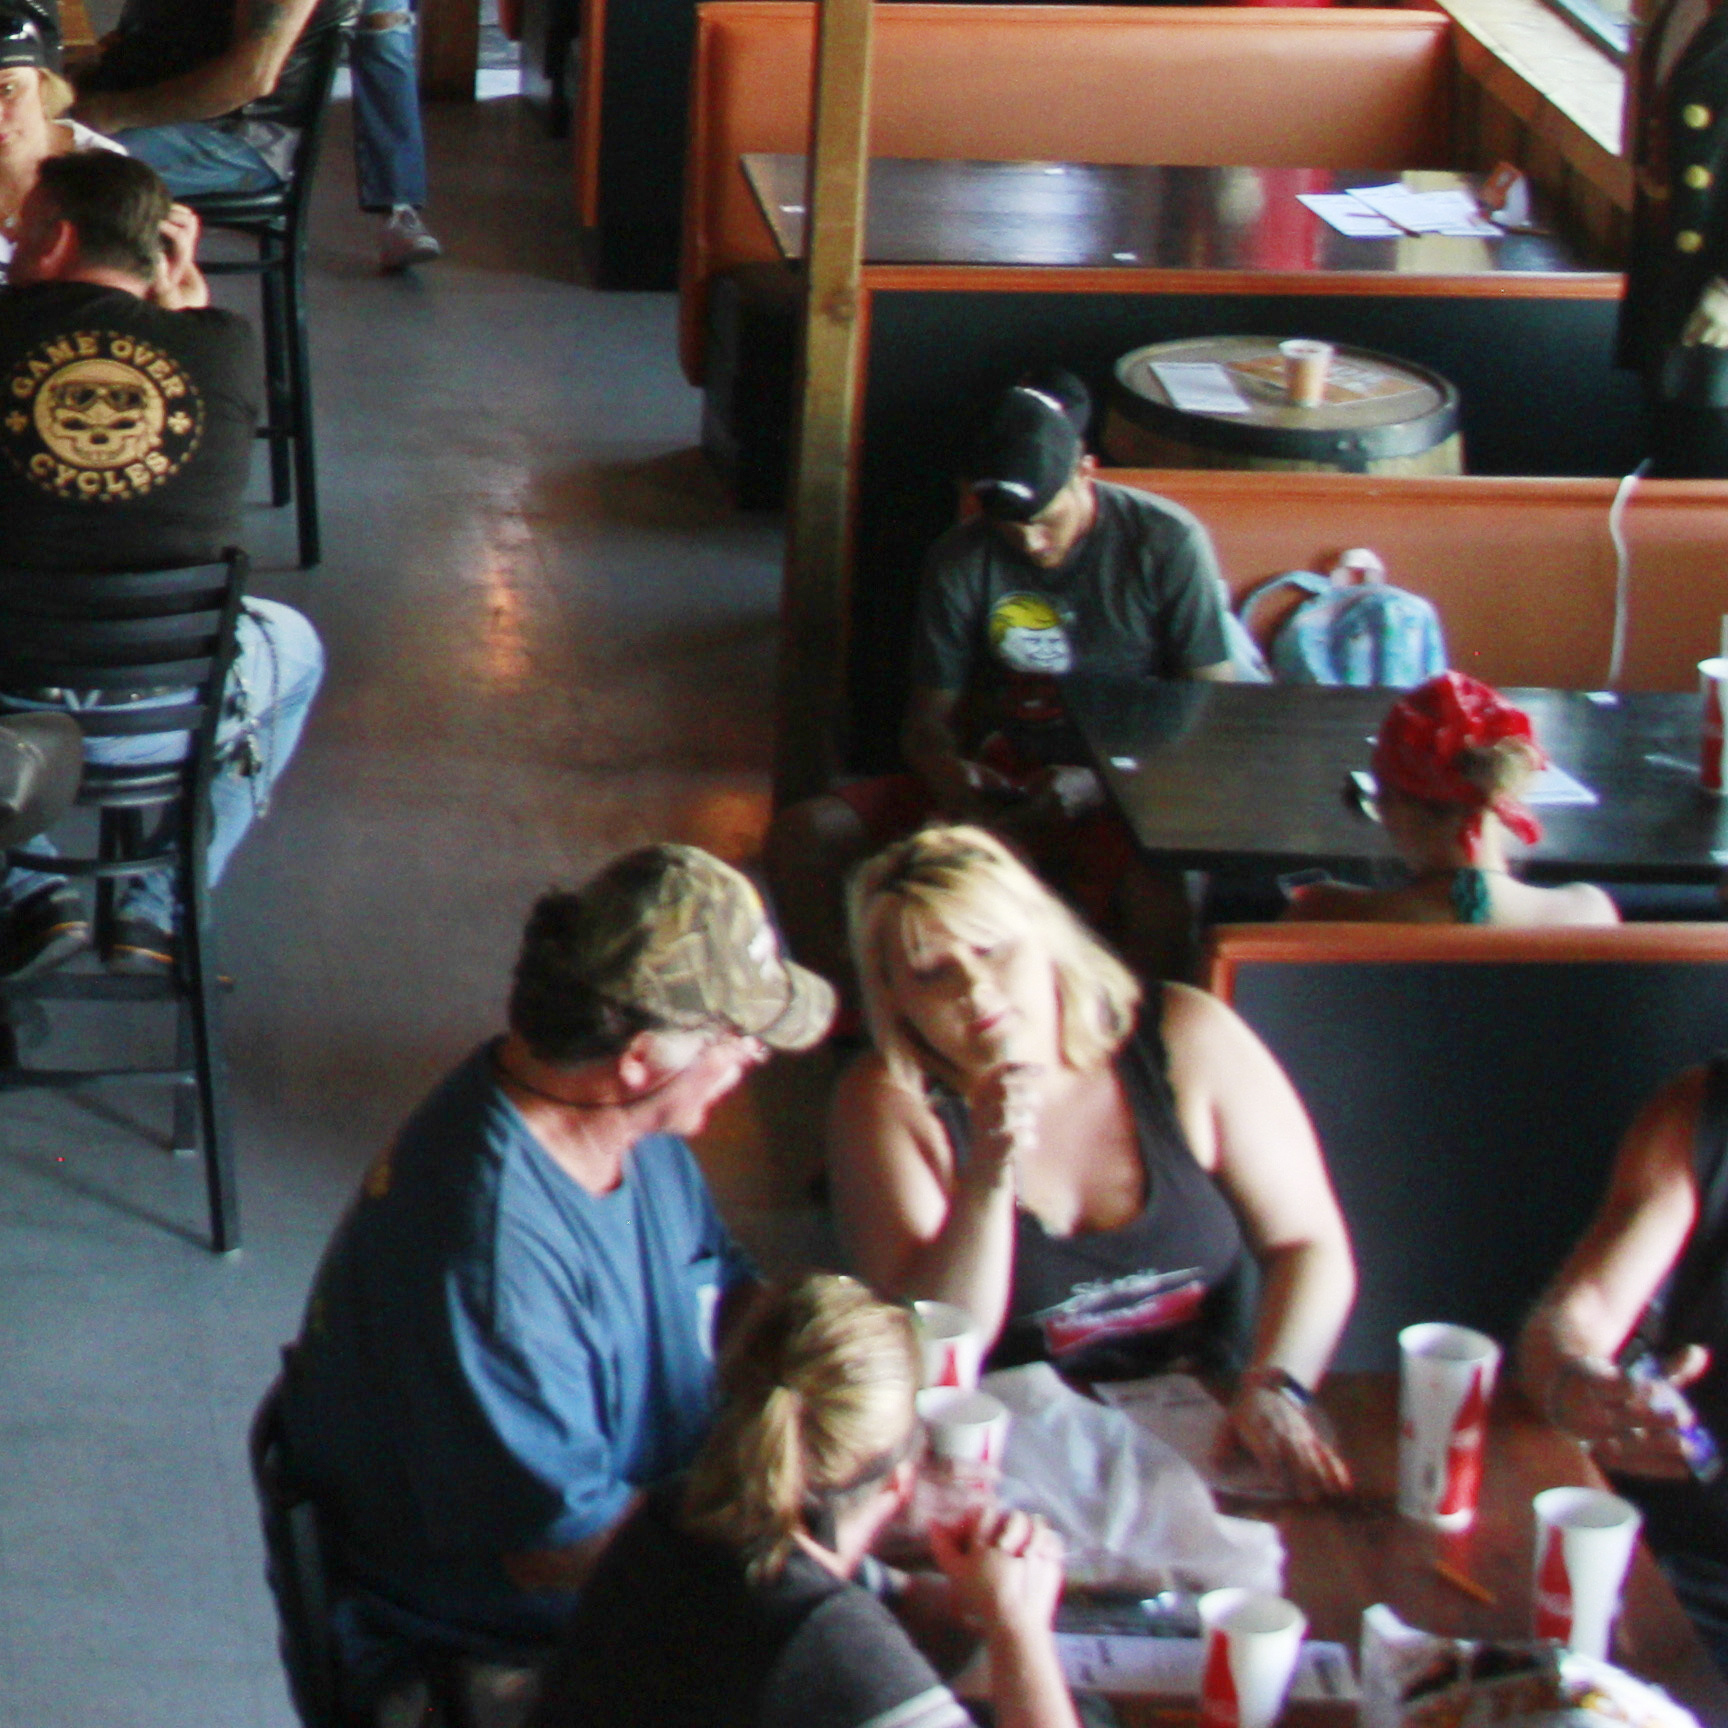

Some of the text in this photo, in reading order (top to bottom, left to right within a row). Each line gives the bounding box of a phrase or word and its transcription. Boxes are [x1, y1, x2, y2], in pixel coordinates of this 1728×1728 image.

[11, 336, 186, 399] GAME OVER
[30, 450, 171, 496] CYCLES
